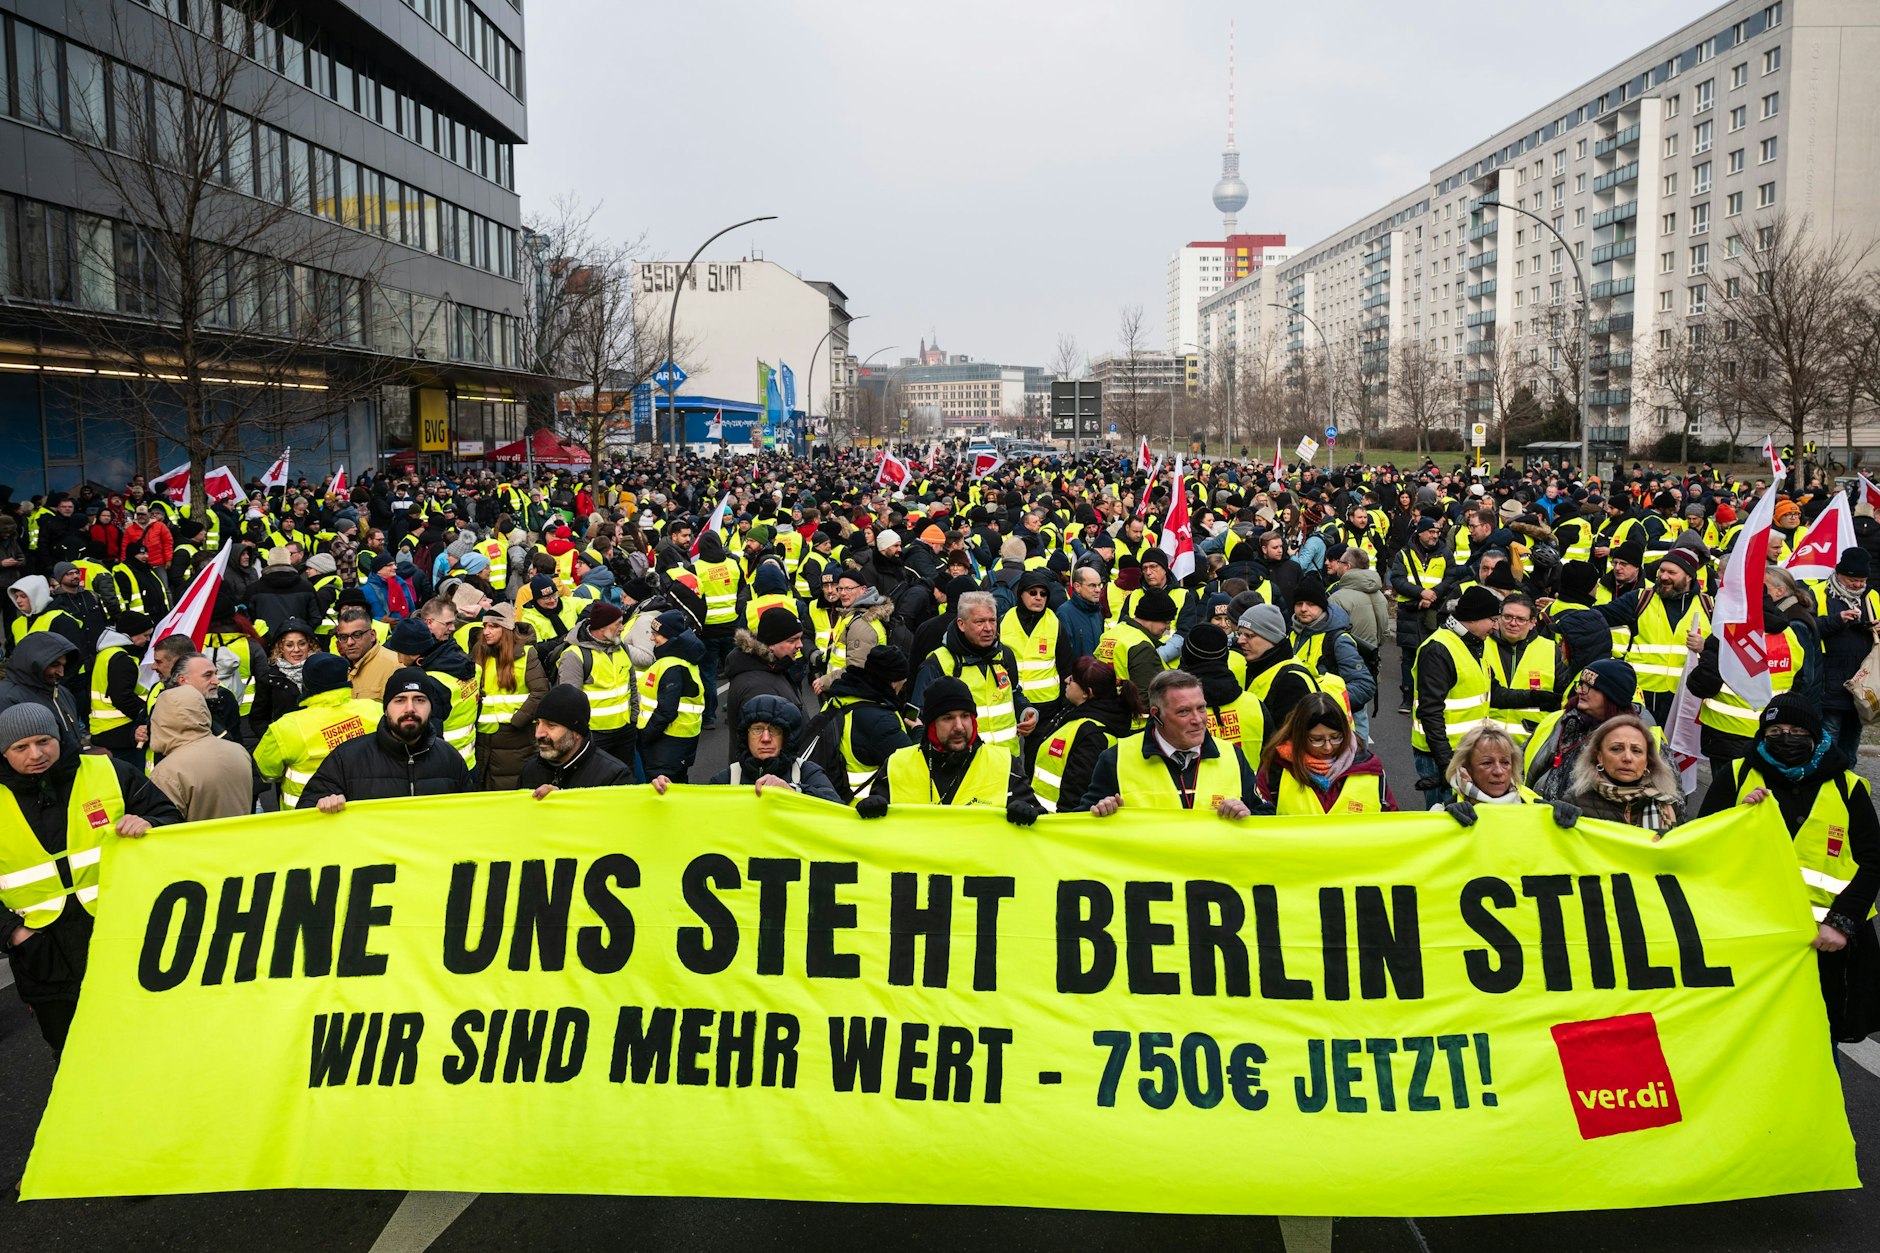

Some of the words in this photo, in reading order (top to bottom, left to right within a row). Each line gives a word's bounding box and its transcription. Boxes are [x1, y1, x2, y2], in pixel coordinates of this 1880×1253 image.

[708, 264, 741, 292] SLIM
[424, 419, 446, 443] BVG
[322, 718, 363, 740] ZUSAMMEN
[1219, 725, 1241, 737] MEHR
[138, 864, 396, 992] OHNE
[444, 854, 640, 976] UNS
[677, 854, 1015, 994] STEHT
[1056, 879, 1424, 1001] BERLIN
[1460, 873, 1734, 994] STILL
[309, 1012, 424, 1088] WIR
[443, 1009, 589, 1086] SIND
[609, 1006, 800, 1089] MEHR
[829, 1017, 1013, 1104] WERT
[1093, 1031, 1269, 1112] 750€
[1295, 1033, 1498, 1113] JETZT!
[1577, 1081, 1669, 1109] ver.di
